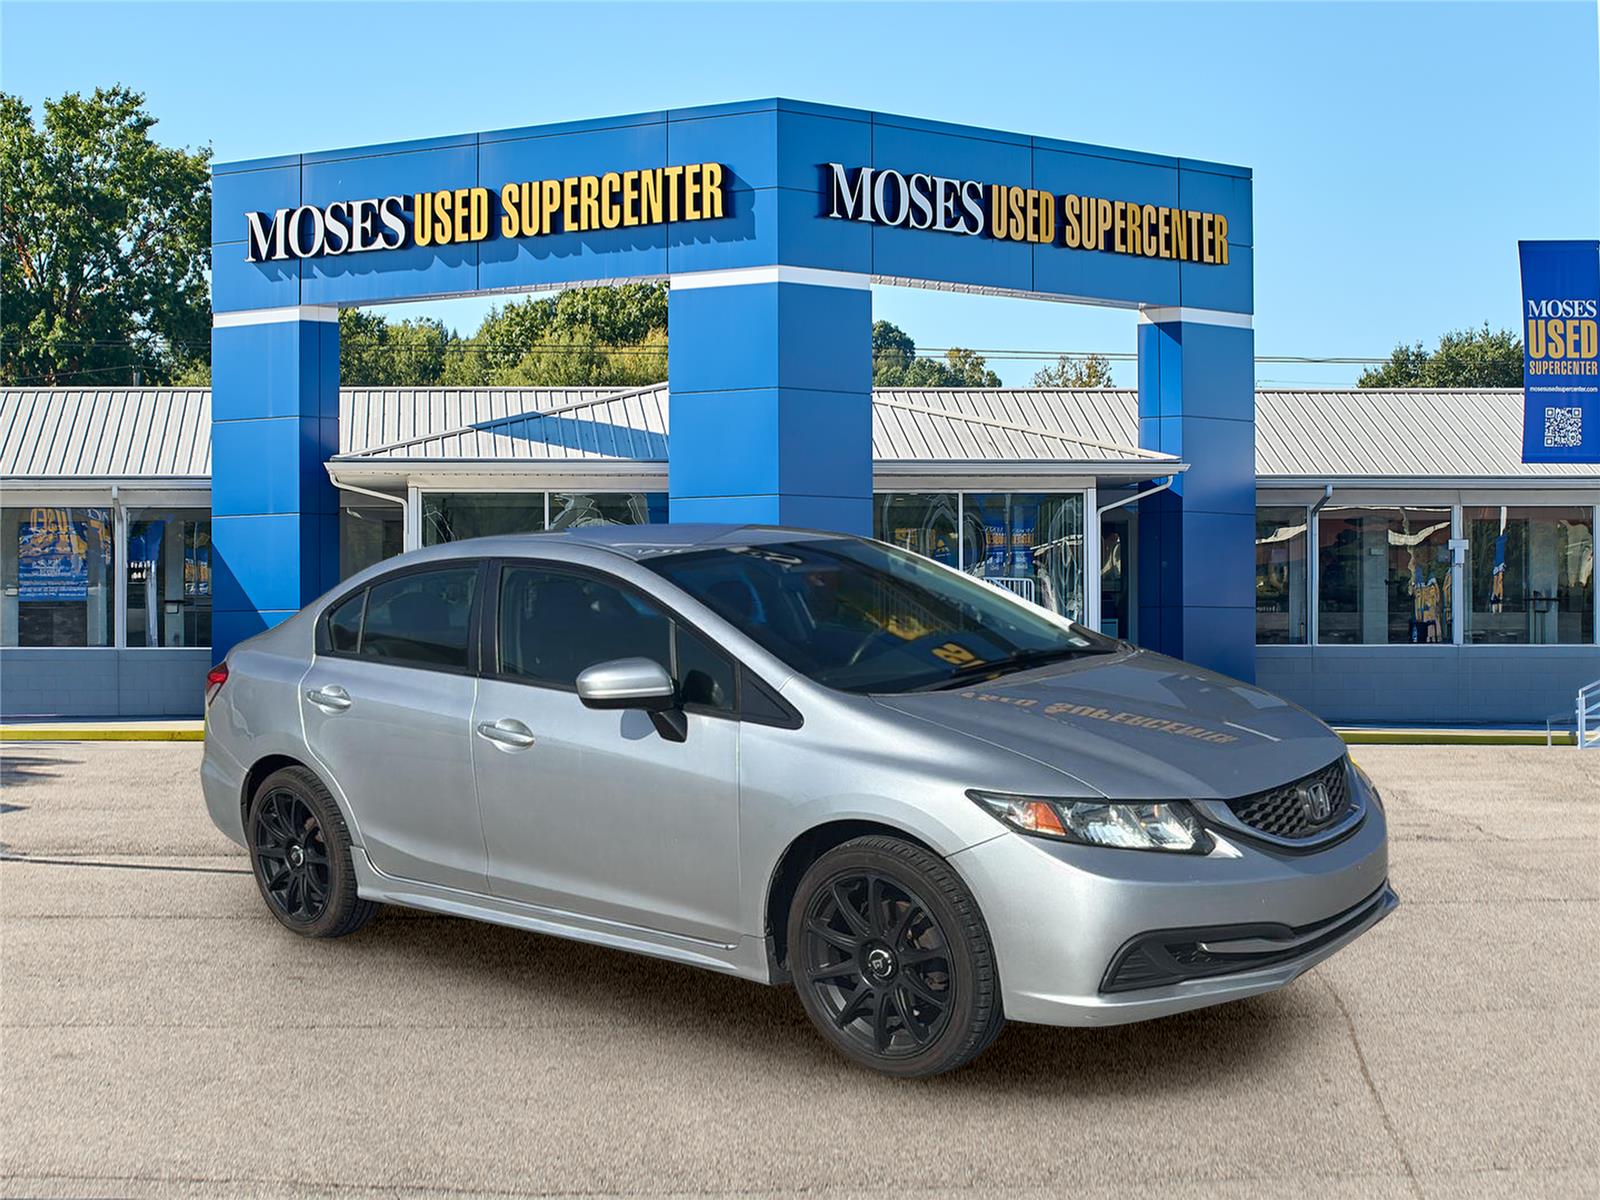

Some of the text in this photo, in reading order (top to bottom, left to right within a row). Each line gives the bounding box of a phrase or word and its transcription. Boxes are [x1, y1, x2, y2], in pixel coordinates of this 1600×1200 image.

[244, 162, 724, 263] MOSES USED SUPERCENTER
[829, 162, 1230, 265] MOSES USED SUPERCENTER
[1528, 299, 1598, 318] MOSES
[1528, 319, 1599, 359] USED
[1529, 360, 1598, 376] SUPERCENTER
